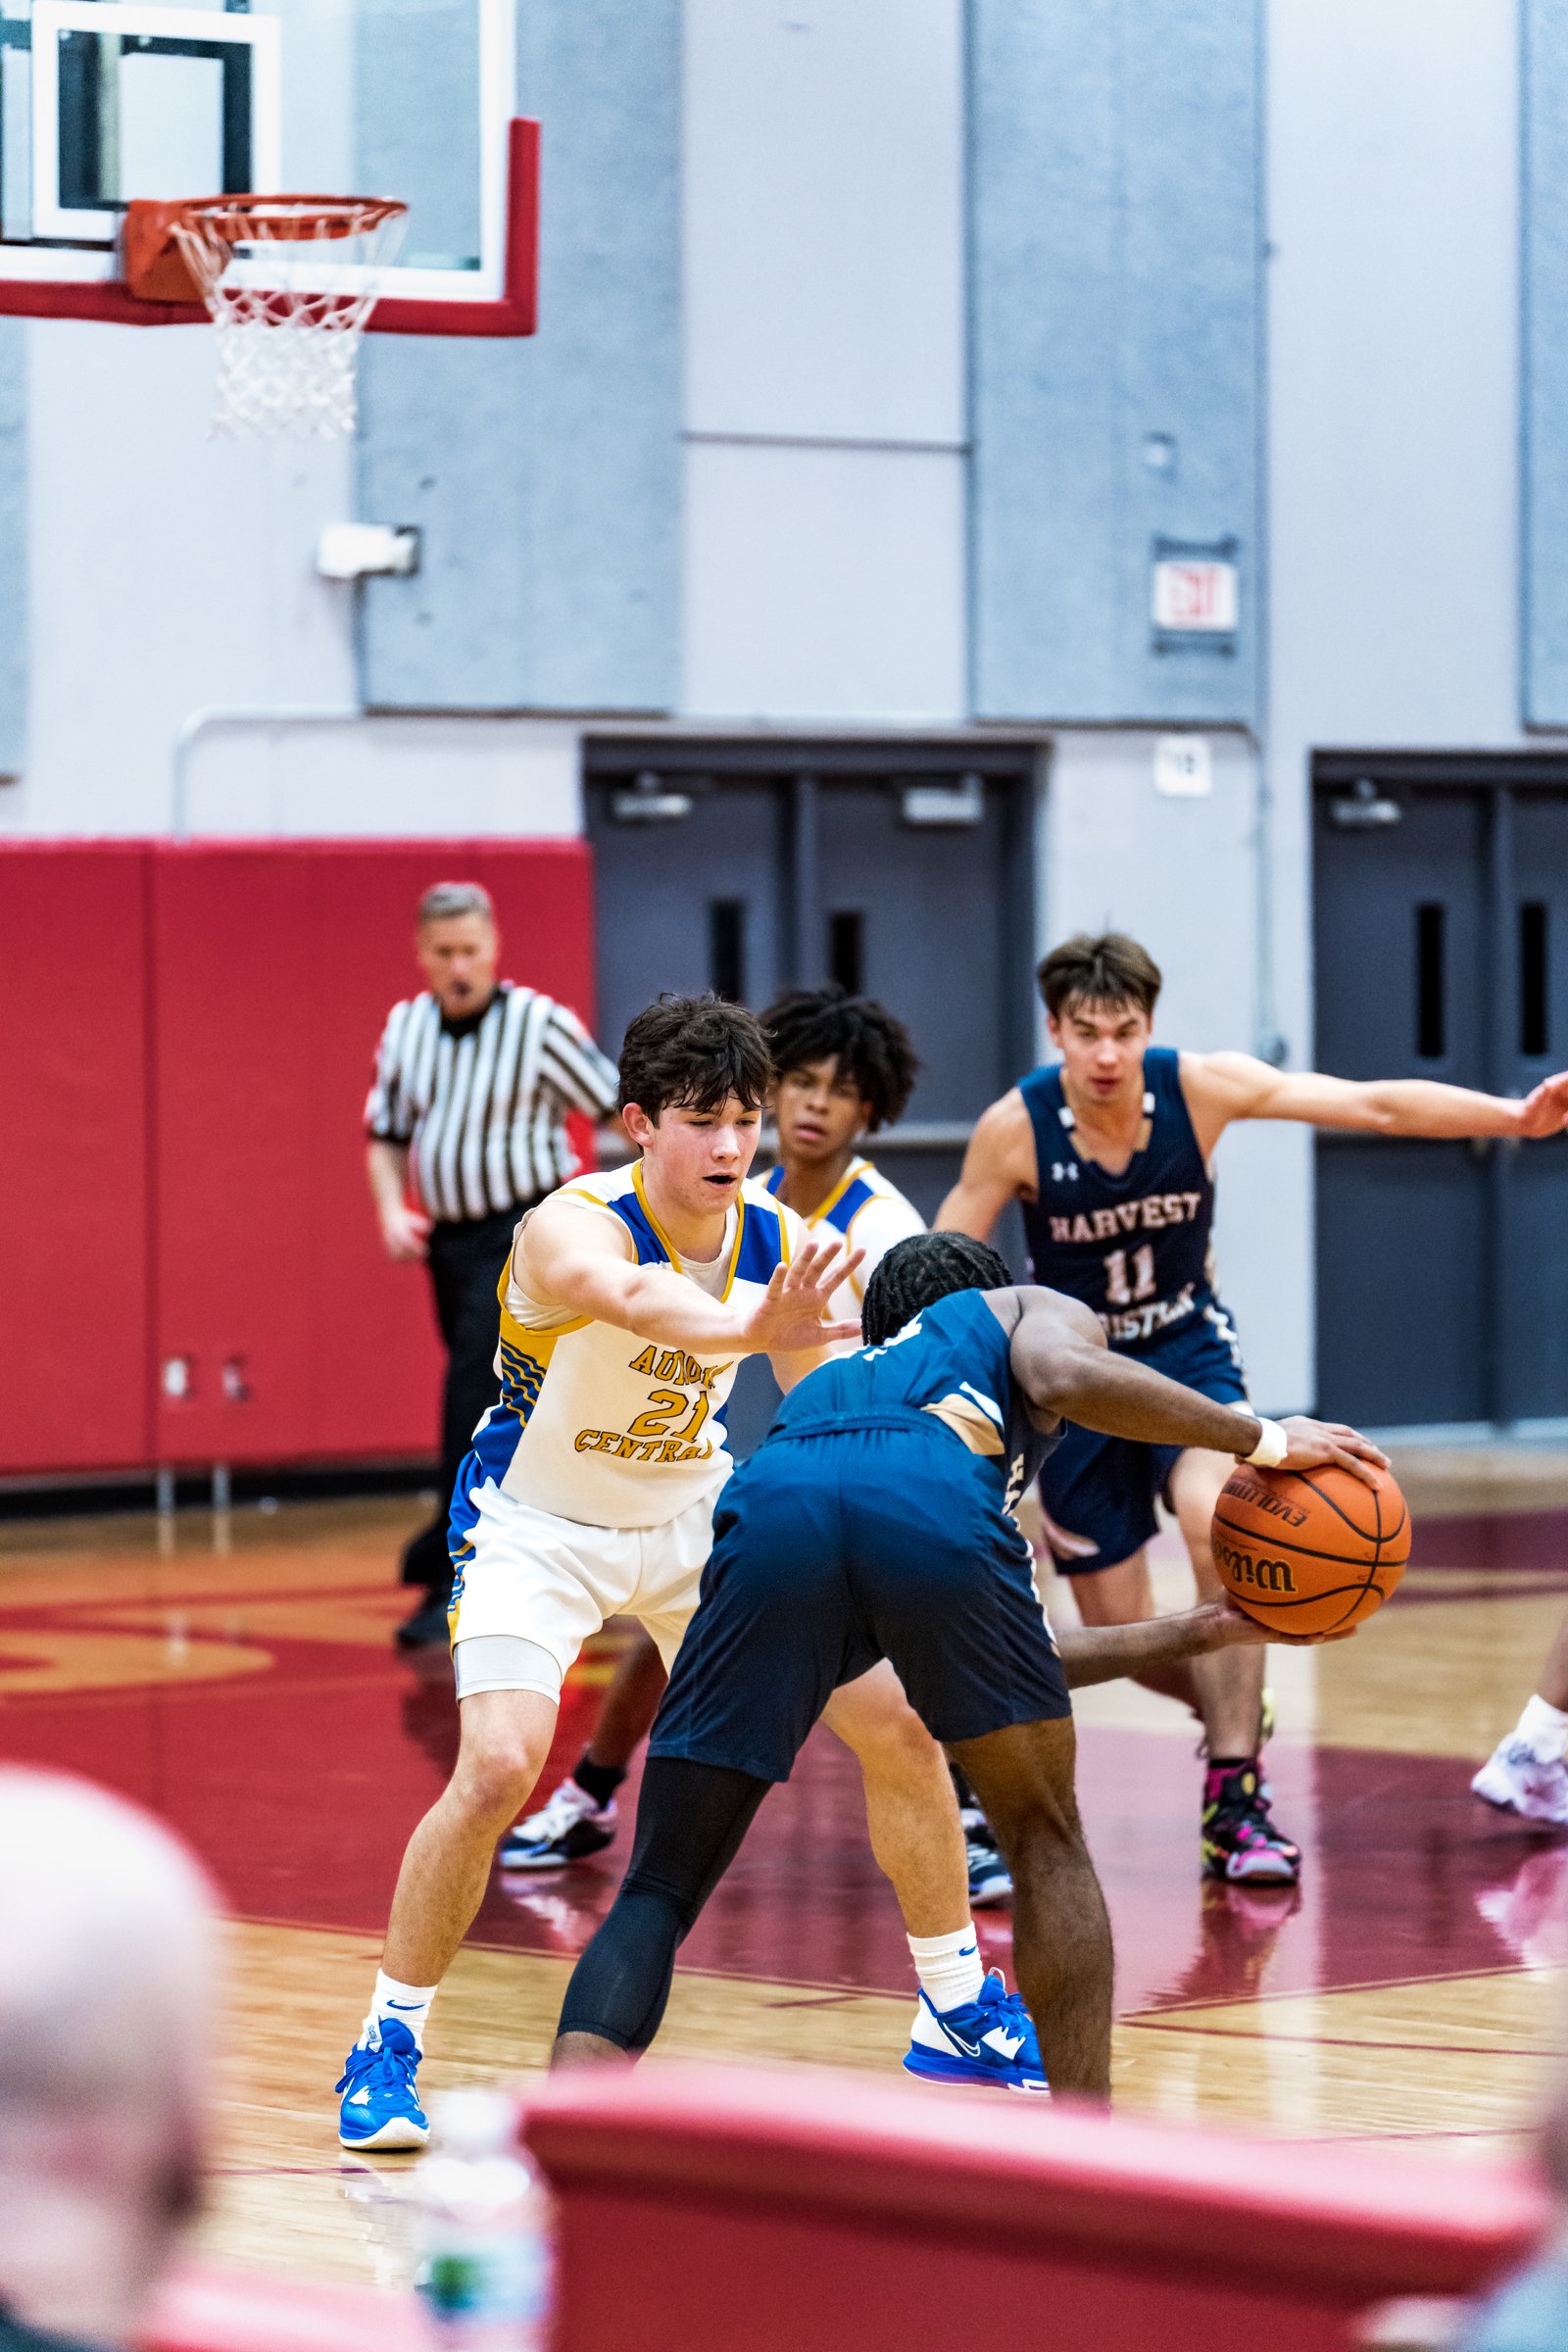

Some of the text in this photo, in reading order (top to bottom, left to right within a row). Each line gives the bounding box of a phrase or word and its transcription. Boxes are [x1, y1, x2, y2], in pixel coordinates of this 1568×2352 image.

[1049, 1192, 1201, 1243] HARVEST
[1103, 1245, 1156, 1305] 11
[627, 1389, 710, 1444] 21
[1212, 1538, 1298, 1592] Wilso
